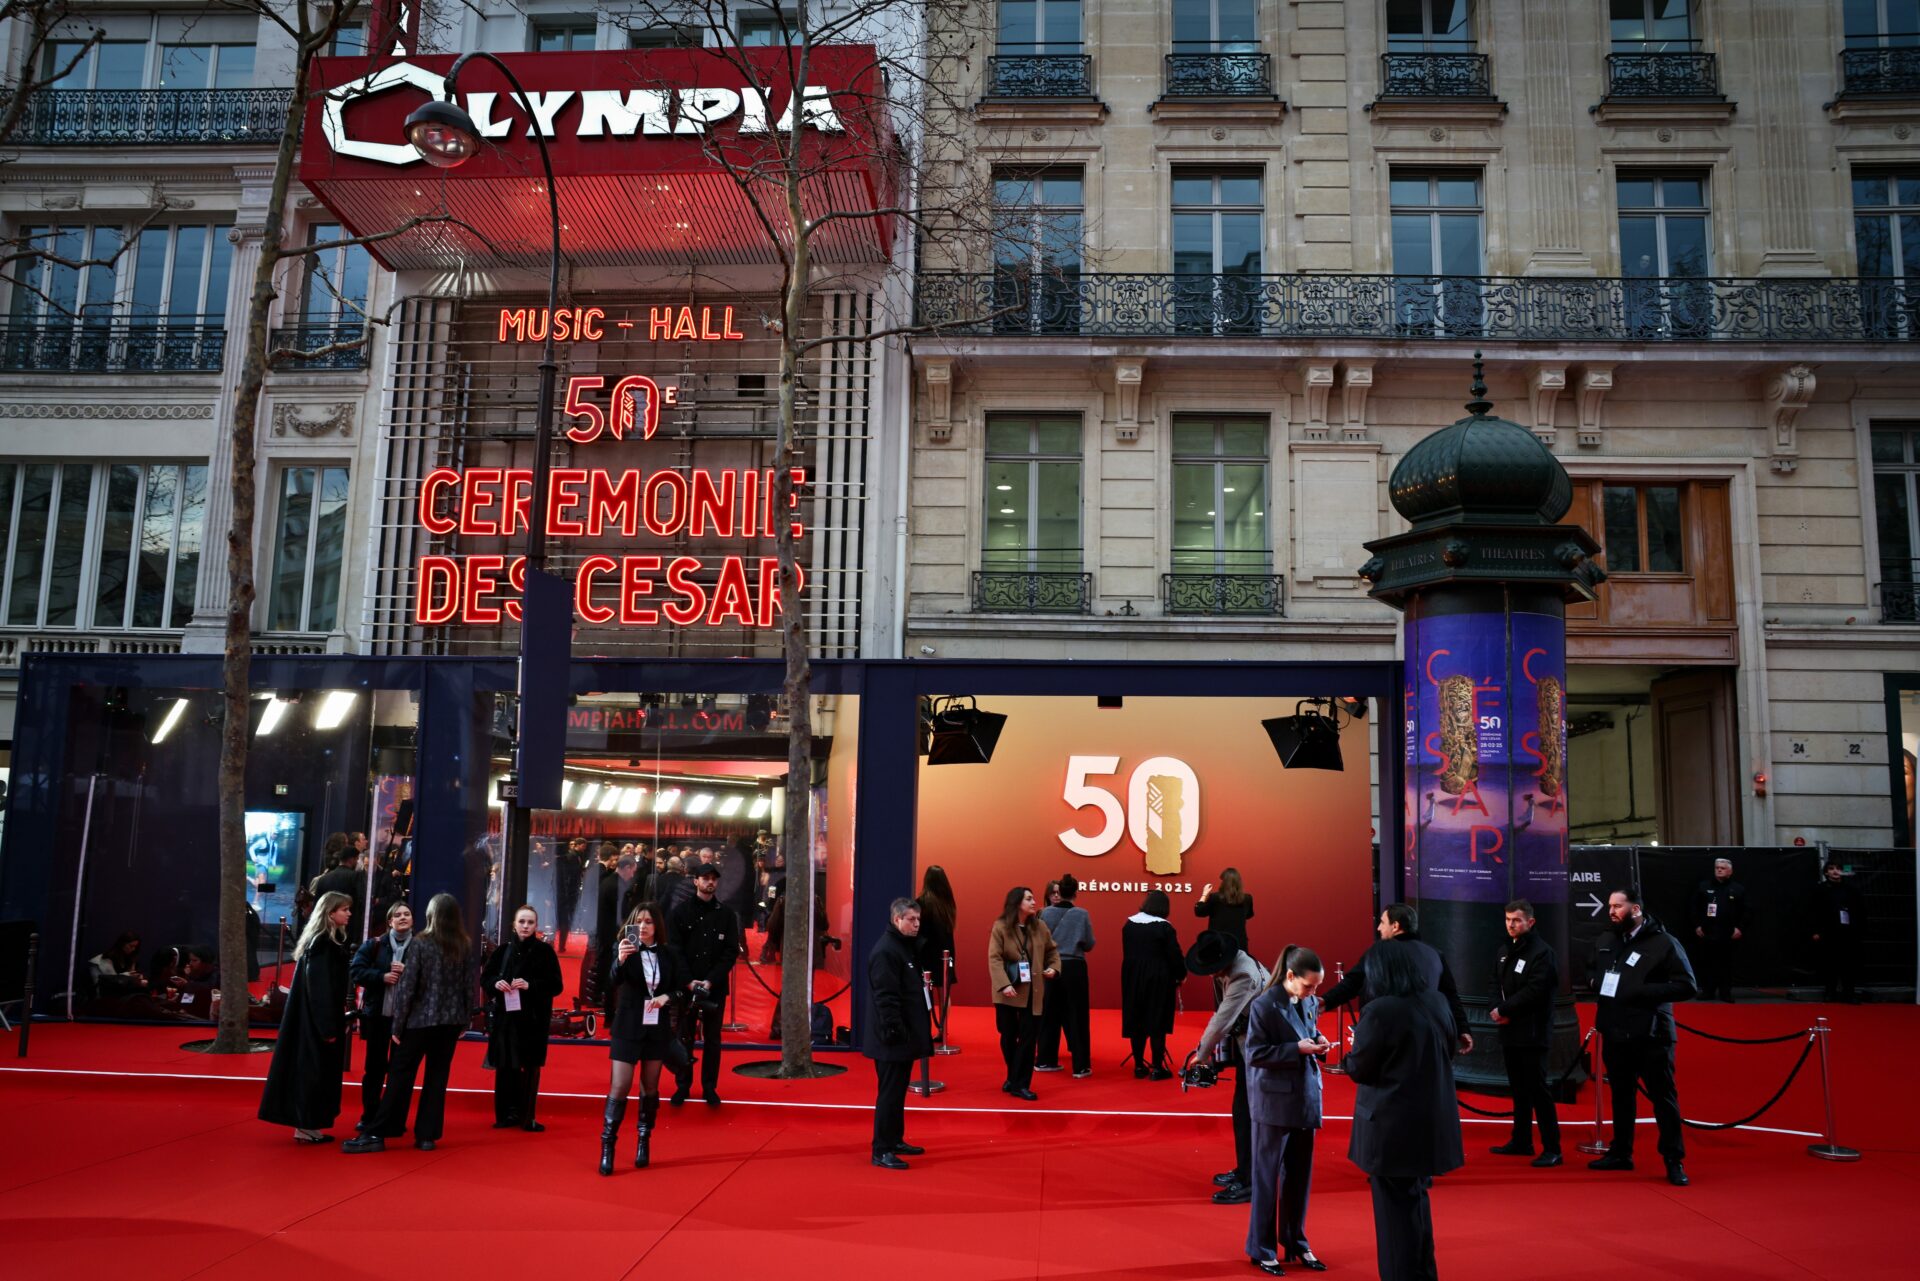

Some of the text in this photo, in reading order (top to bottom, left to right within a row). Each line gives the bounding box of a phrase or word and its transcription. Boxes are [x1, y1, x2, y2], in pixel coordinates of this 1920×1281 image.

[322, 62, 846, 165] OLYMPIA
[499, 307, 604, 342] MUSIC
[650, 306, 744, 340] HALL
[419, 468, 806, 537] CEREMONIE
[417, 555, 805, 627] DES CESAR
[1480, 716, 1501, 729] 50
[1793, 743, 1805, 754] 24
[1849, 743, 1861, 754] 22
[1057, 755, 1200, 857] 50
[1078, 879, 1193, 893] RÉMONIE 2025
[1569, 872, 1602, 882] AIRE
